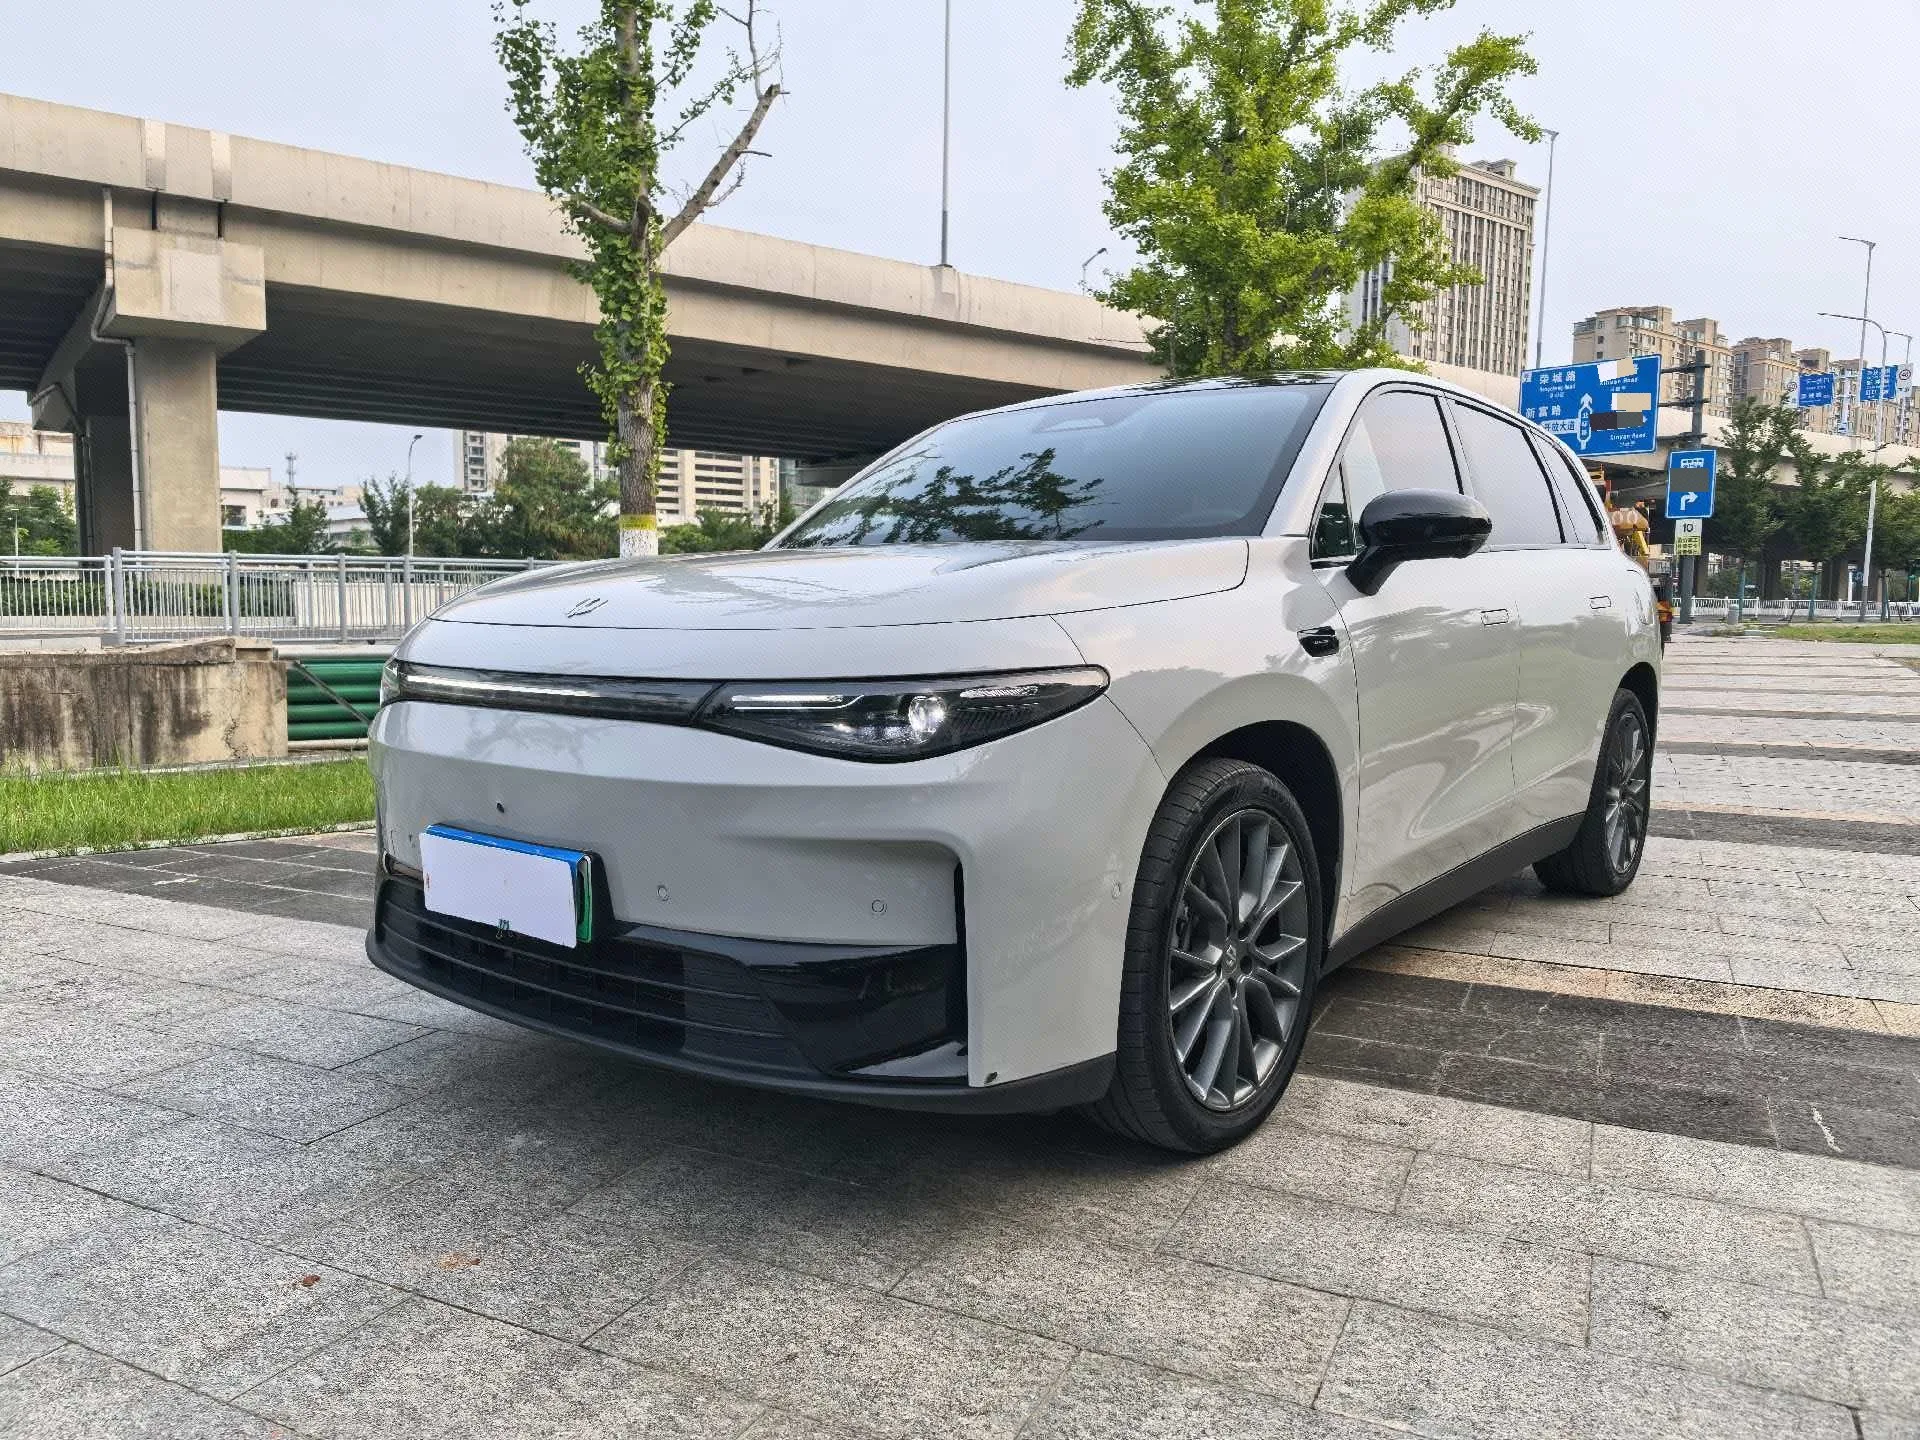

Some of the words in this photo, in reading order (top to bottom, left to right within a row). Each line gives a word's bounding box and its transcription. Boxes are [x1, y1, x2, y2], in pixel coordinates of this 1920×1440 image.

[1539, 371, 1576, 385] 荣城路
[1526, 404, 1561, 418] 新富路
[1544, 420, 1575, 431] 开放大道
[1682, 523, 1693, 532] 10
